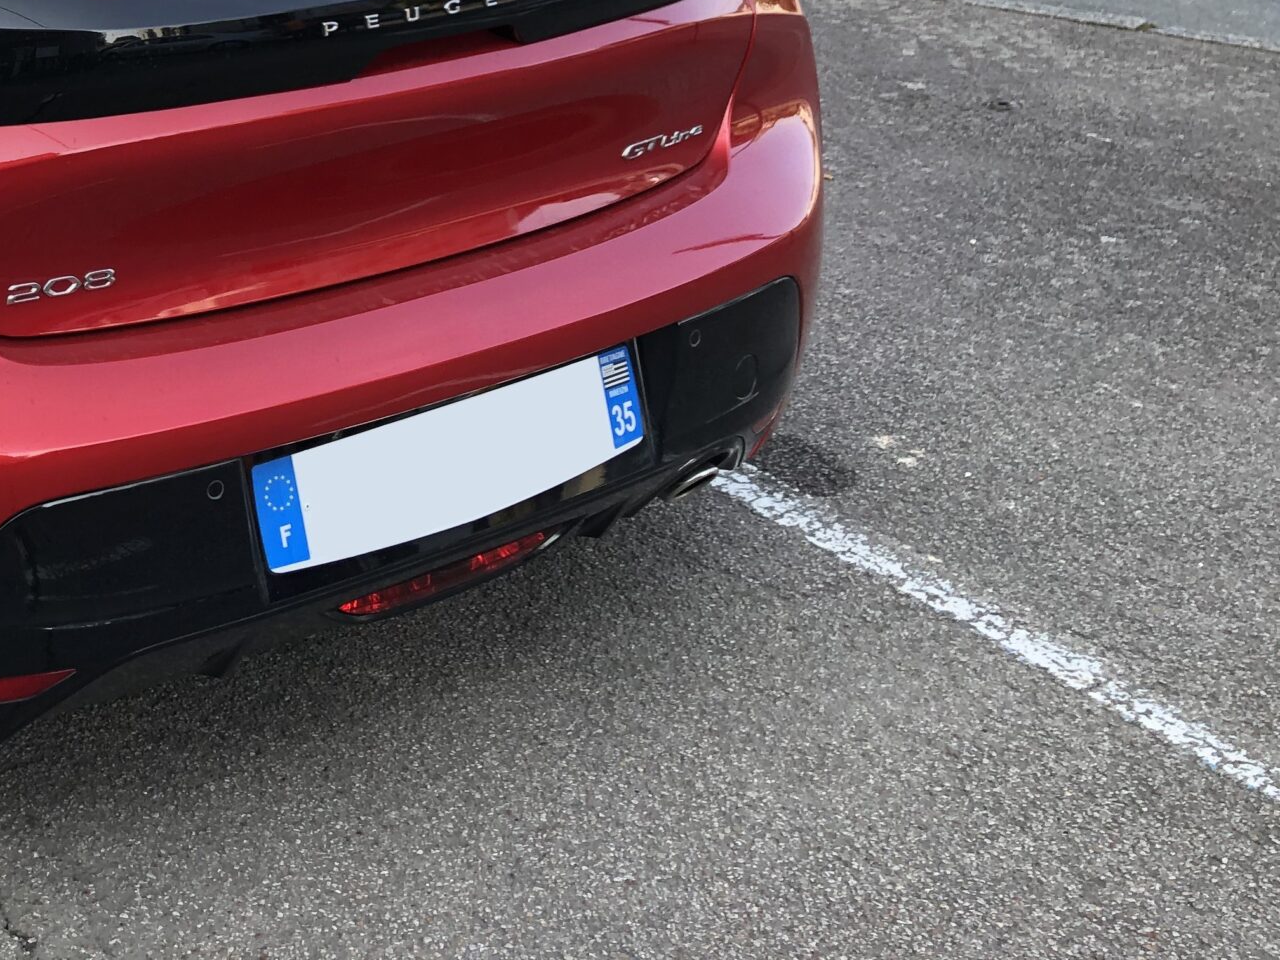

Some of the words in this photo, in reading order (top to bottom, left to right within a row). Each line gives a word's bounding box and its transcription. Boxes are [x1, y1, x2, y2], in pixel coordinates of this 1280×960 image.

[6, 268, 116, 305] 208
[611, 400, 637, 437] 35
[279, 523, 292, 548] F
